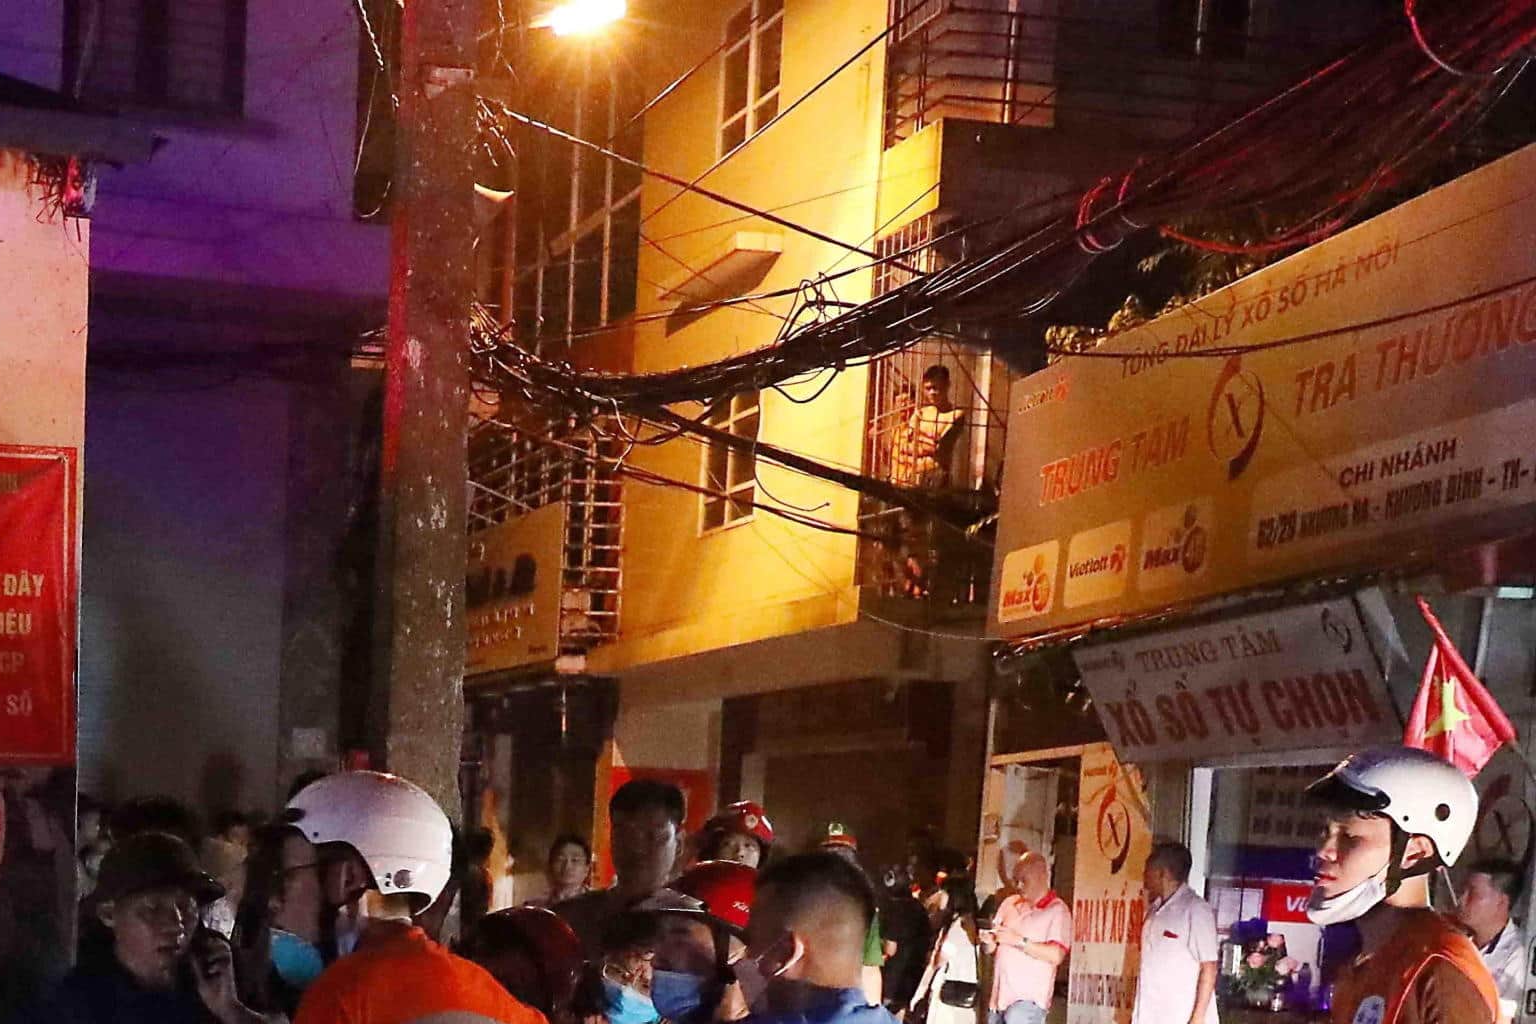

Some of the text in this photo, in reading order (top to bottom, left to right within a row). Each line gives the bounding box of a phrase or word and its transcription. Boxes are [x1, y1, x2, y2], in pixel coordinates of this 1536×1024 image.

[1040, 439, 1122, 506] TRUNG
[1338, 438, 1458, 489] CHI NHÁNH
[1135, 640, 1217, 673] TRUNG
[1222, 625, 1281, 659] TÂM
[1156, 672, 1209, 743] SỐ
